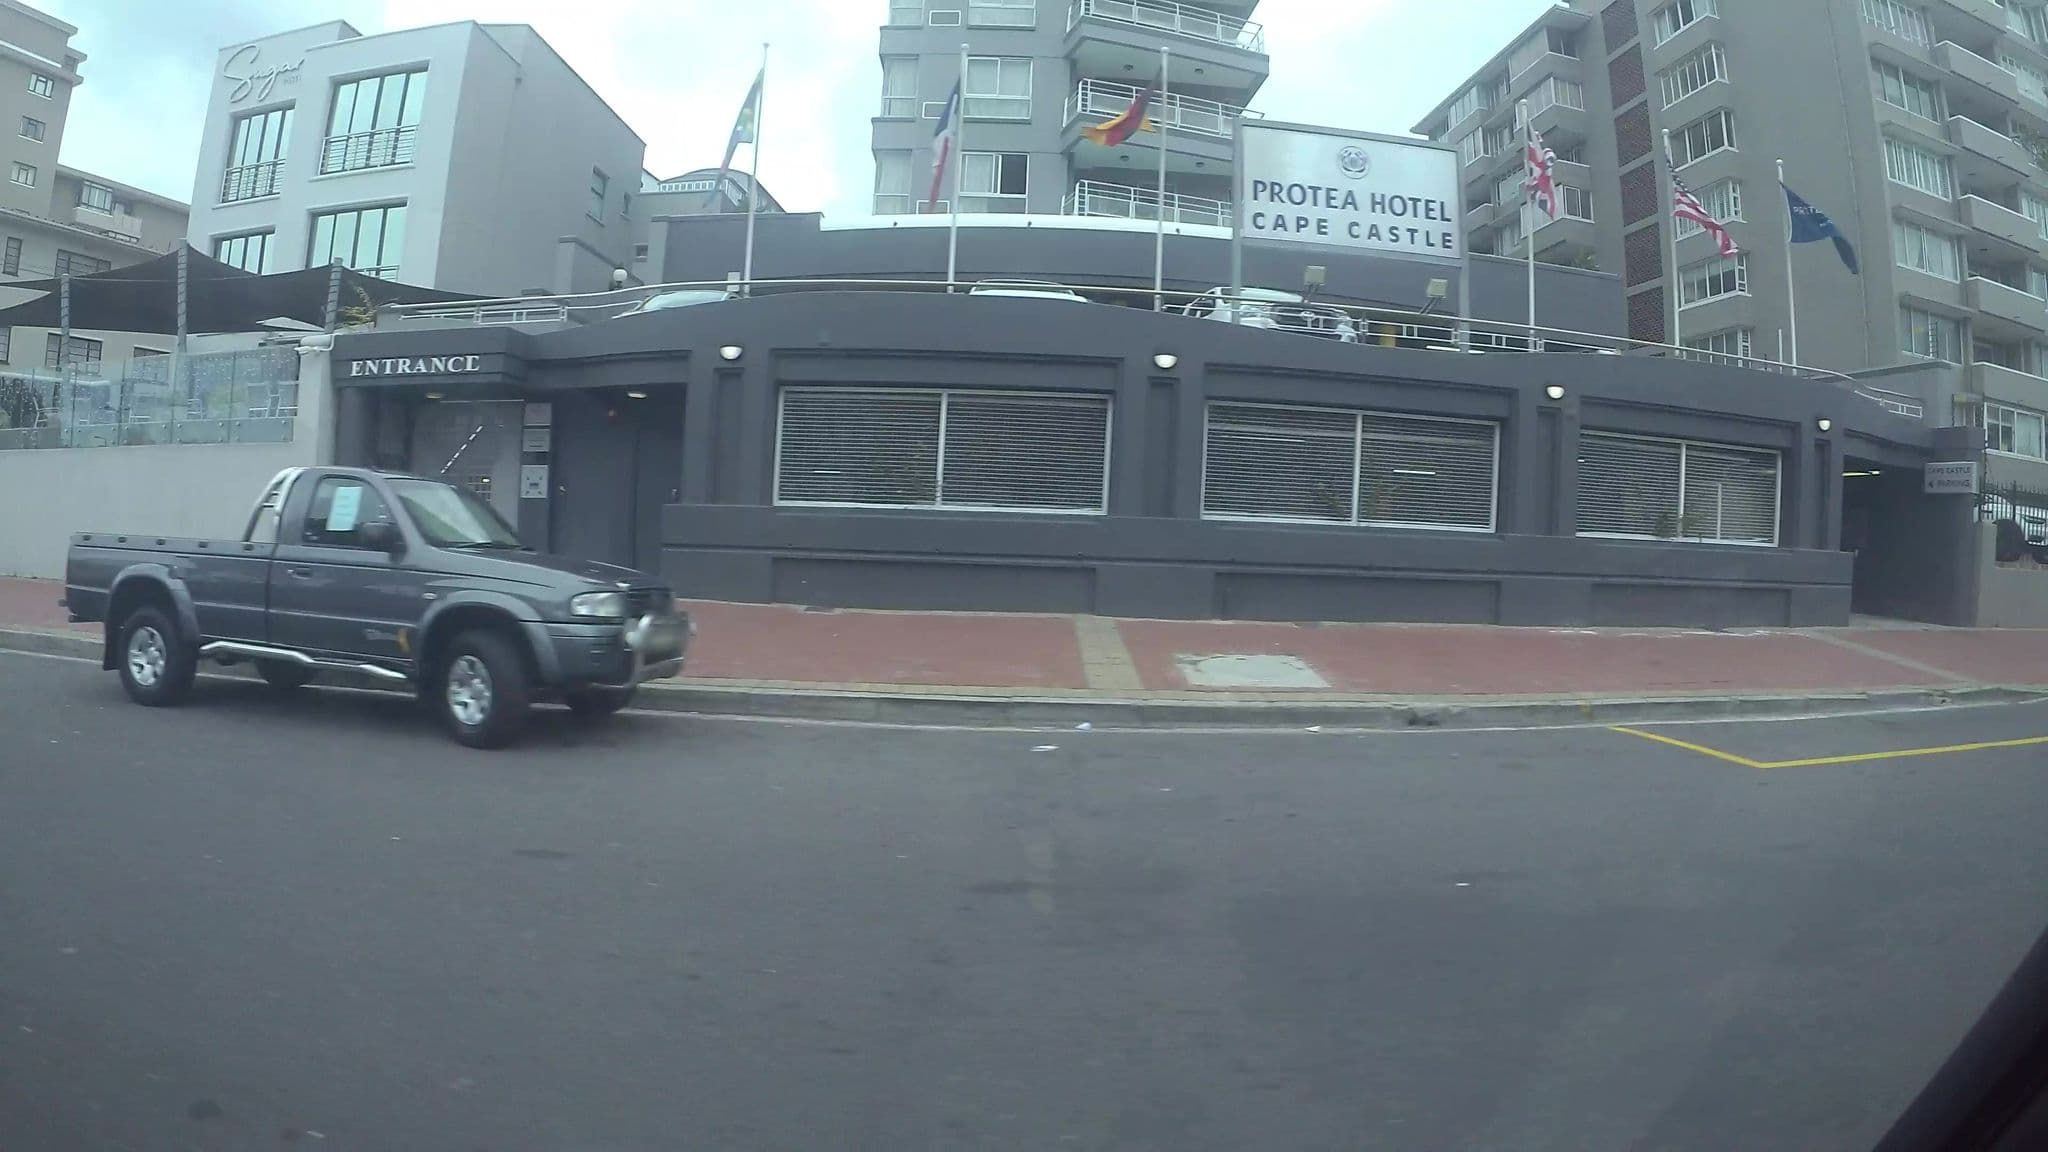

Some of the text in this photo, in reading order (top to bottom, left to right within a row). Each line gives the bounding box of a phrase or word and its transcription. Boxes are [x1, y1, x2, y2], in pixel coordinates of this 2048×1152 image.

[223, 45, 305, 103] Sugar
[1252, 179, 1452, 222] PROTEA HOTEL
[1252, 212, 1453, 249] CAPE CASTLE
[350, 355, 481, 377] ENTRANCE
[1945, 465, 1971, 474] CASTLE
